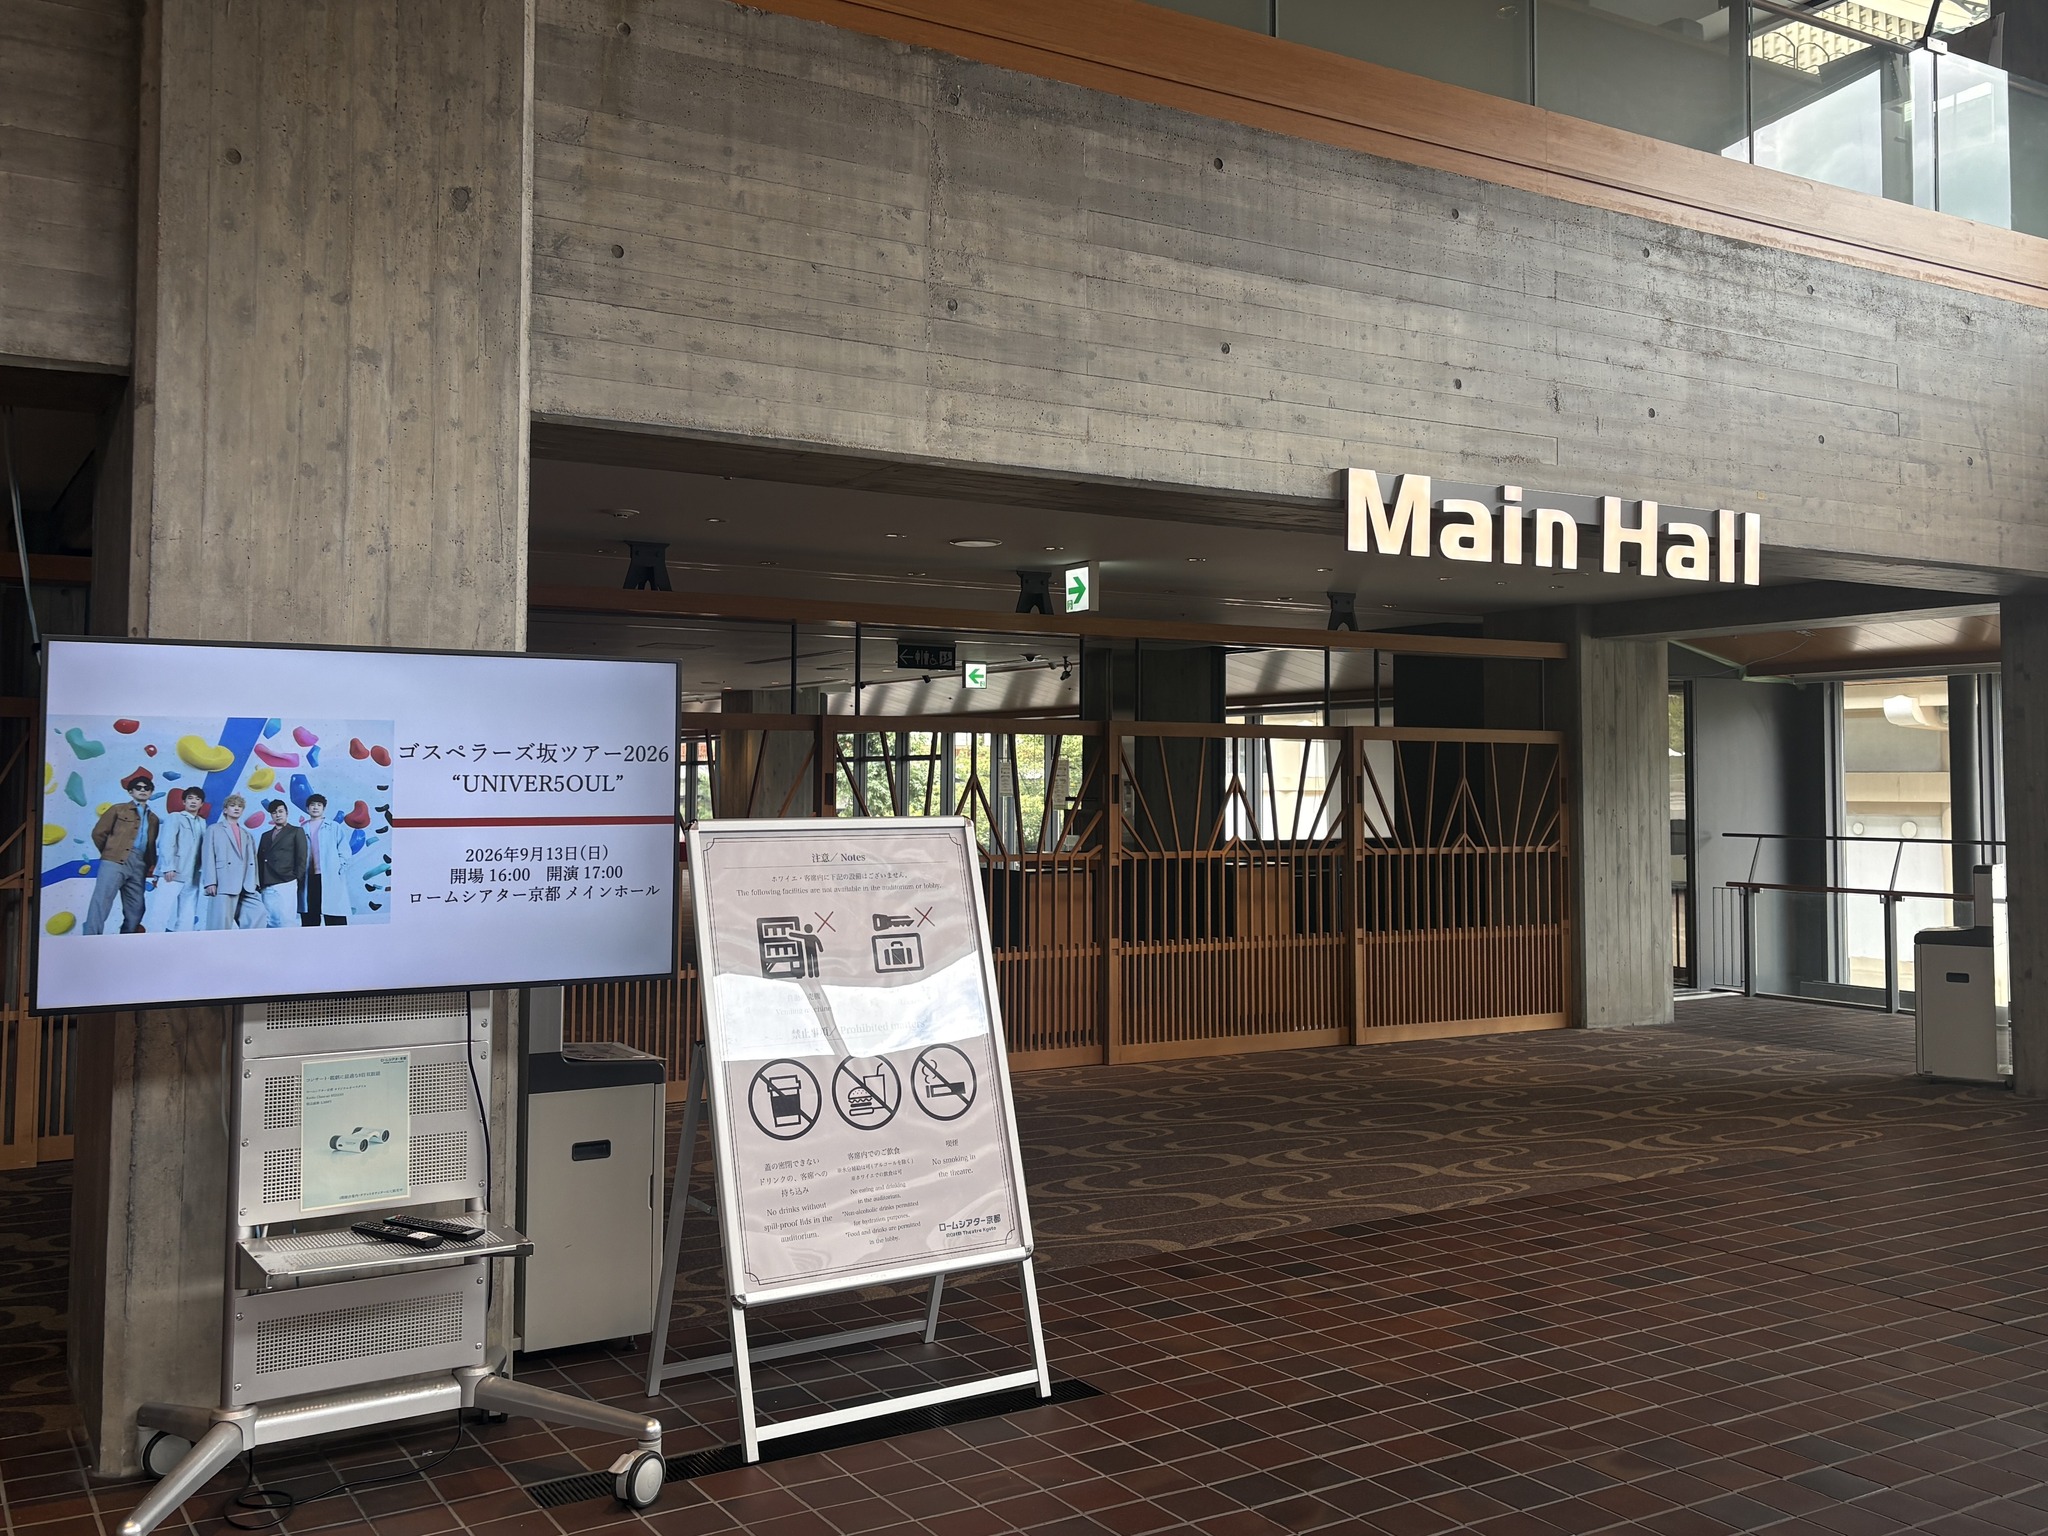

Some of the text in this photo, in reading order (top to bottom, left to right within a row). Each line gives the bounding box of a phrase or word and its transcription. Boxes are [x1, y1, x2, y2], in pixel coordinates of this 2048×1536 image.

[1346, 467, 1761, 586] Main Hall
[399, 742, 669, 764] ゴスペラーズ坂ツアー2026
[452, 774, 624, 793] “UNIVER5OUL”
[465, 844, 609, 863] 2026年9月13日(日)
[840, 852, 866, 863] Notes
[450, 864, 623, 885] 開場 16:00 開演 17:00
[410, 884, 661, 904] ロームシアター京都 メインホール
[751, 888, 781, 896] following
[782, 886, 809, 895] facilities
[834, 885, 861, 893] available
[882, 883, 915, 891] auditorium
[840, 1020, 889, 1035] Prohibited
[847, 1146, 901, 1161] 客席内でのご飲食
[942, 1155, 969, 1164] smoking
[764, 1158, 820, 1172] 蓋の密閉できない
[760, 1170, 828, 1186] ドリンクの、客席への
[950, 1168, 974, 1177] theatre.
[781, 1187, 809, 1198] 持ち込み
[886, 1182, 906, 1190] drinking
[778, 1206, 800, 1215] drinks
[801, 1202, 827, 1211] without
[879, 1204, 895, 1212] drinks
[896, 1201, 919, 1210] permitted
[764, 1220, 798, 1232] spill-proof
[800, 1218, 812, 1226] lids
[813, 1216, 820, 1224] in
[872, 1226, 887, 1234] drinks
[897, 1221, 921, 1231] permitted
[939, 1213, 1001, 1232] ロームシアター京都
[781, 1232, 819, 1243] auditorium.
